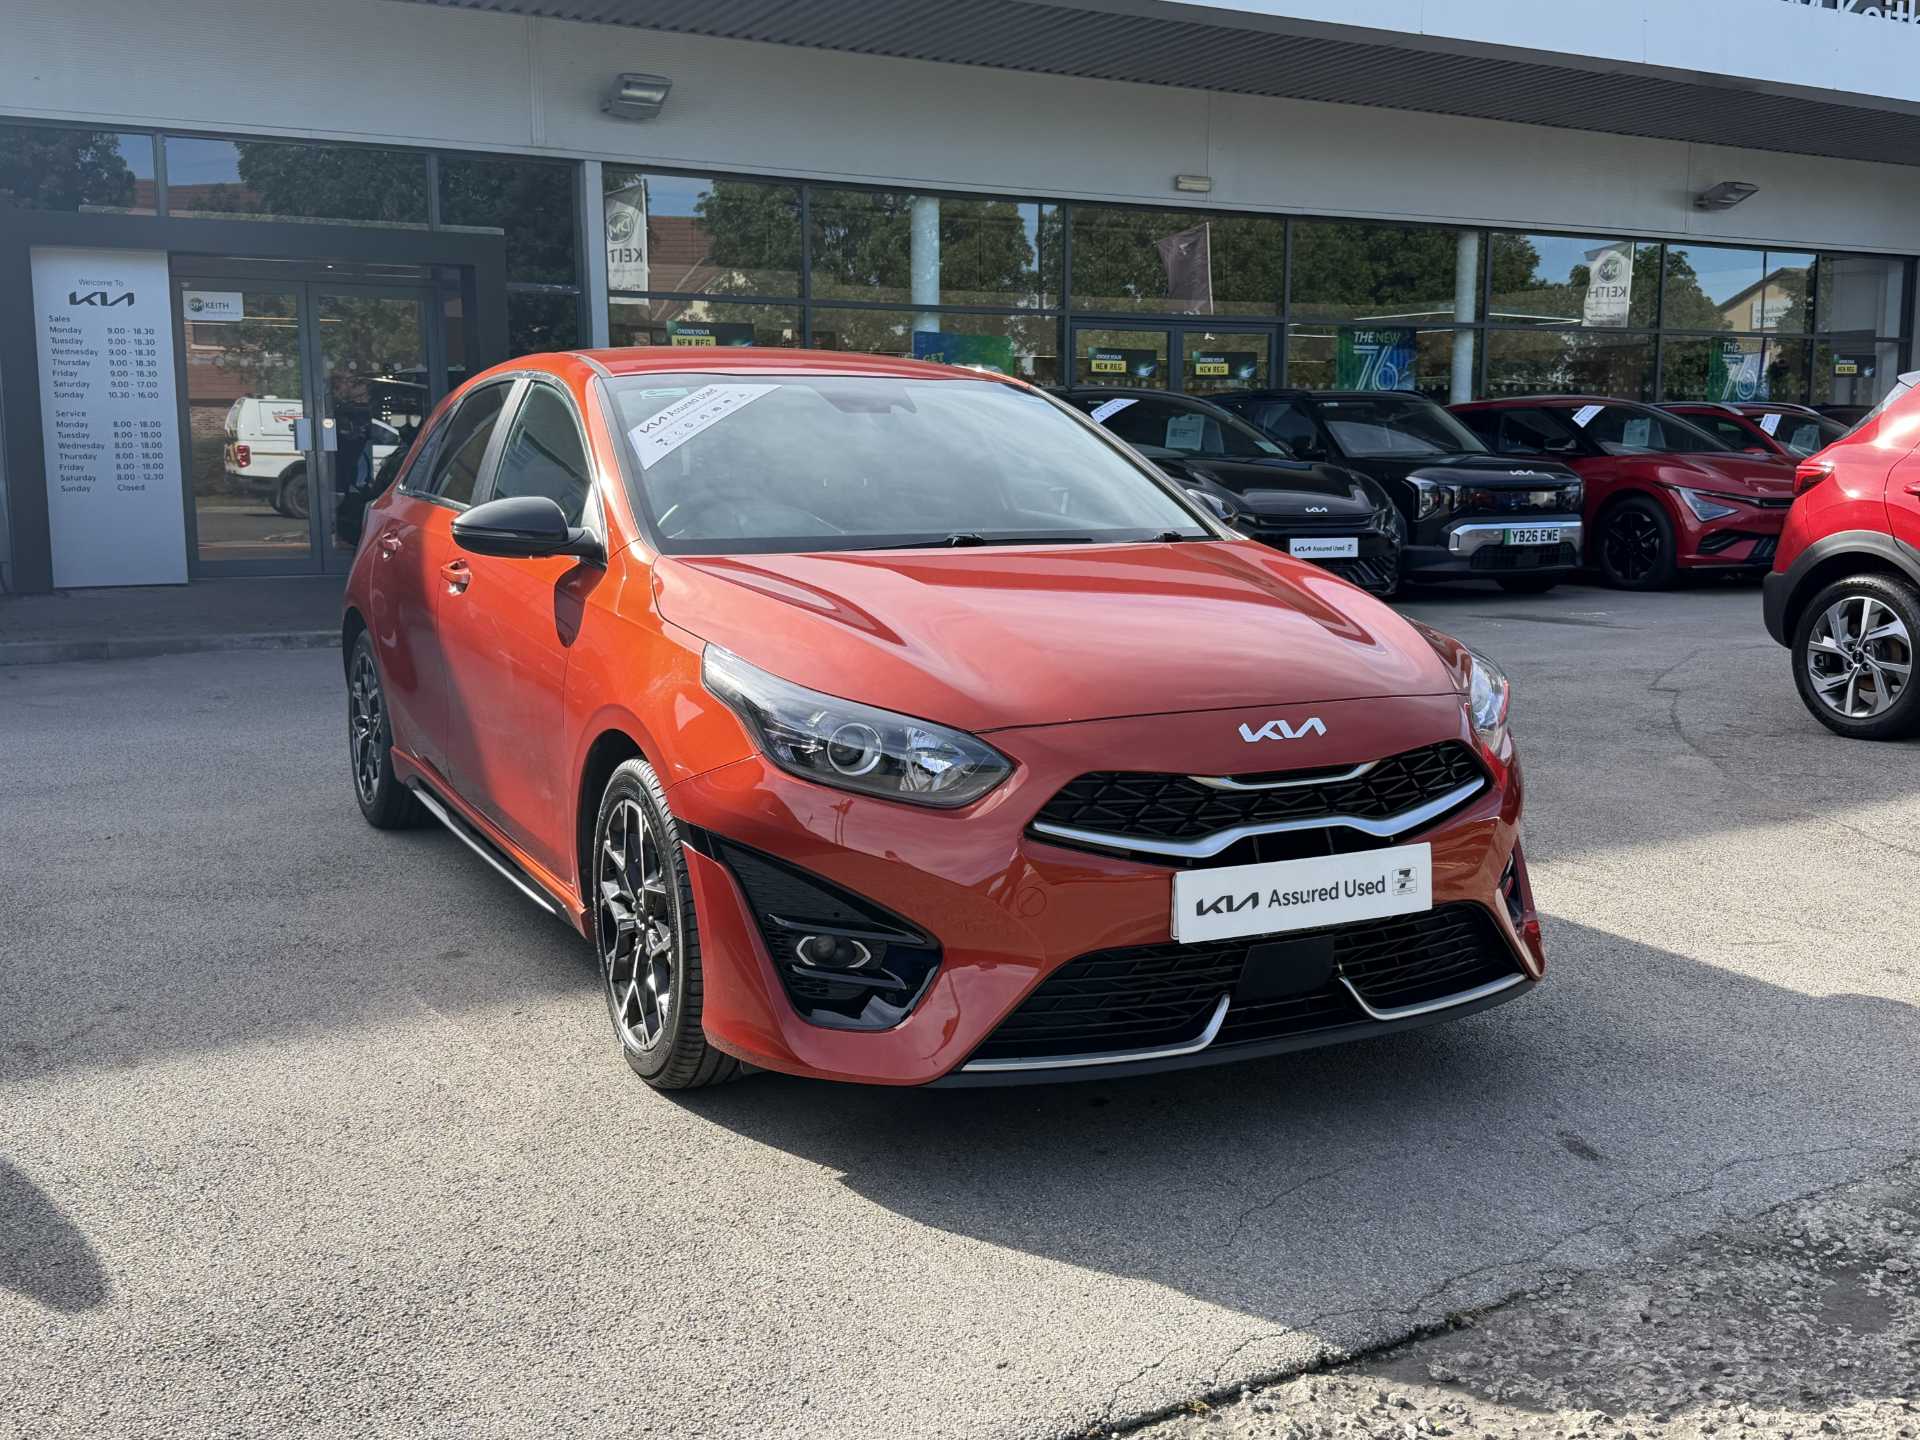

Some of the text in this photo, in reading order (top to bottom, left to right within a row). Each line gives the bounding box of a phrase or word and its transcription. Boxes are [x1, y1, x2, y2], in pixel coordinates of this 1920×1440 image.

[79, 279, 113, 287] Welcome
[69, 291, 135, 307] KIA
[206, 302, 229, 310] KEITH
[50, 326, 82, 335] Monday
[51, 338, 84, 346] Tuesday
[1353, 331, 1400, 344] THE NEW
[1723, 342, 1740, 353] THE
[52, 349, 98, 357] Wednesday
[52, 359, 90, 367] Thursday
[1110, 363, 1123, 371] REG
[1213, 366, 1225, 374] REG
[1353, 345, 1399, 391] 76
[52, 369, 78, 378] Friday
[1721, 354, 1757, 400] 76
[53, 381, 90, 389] Saturday
[54, 392, 85, 400] Sunday
[56, 421, 88, 430] Monday
[640, 415, 668, 434] KIA
[59, 464, 85, 472] Friday
[61, 484, 145, 493] Sunday Closed
[1512, 530, 1538, 543] YB26
[1238, 717, 1327, 742] KIA
[1196, 891, 1260, 917] KIA
[1268, 882, 1339, 908] Assured
[1344, 875, 1386, 897] Used
